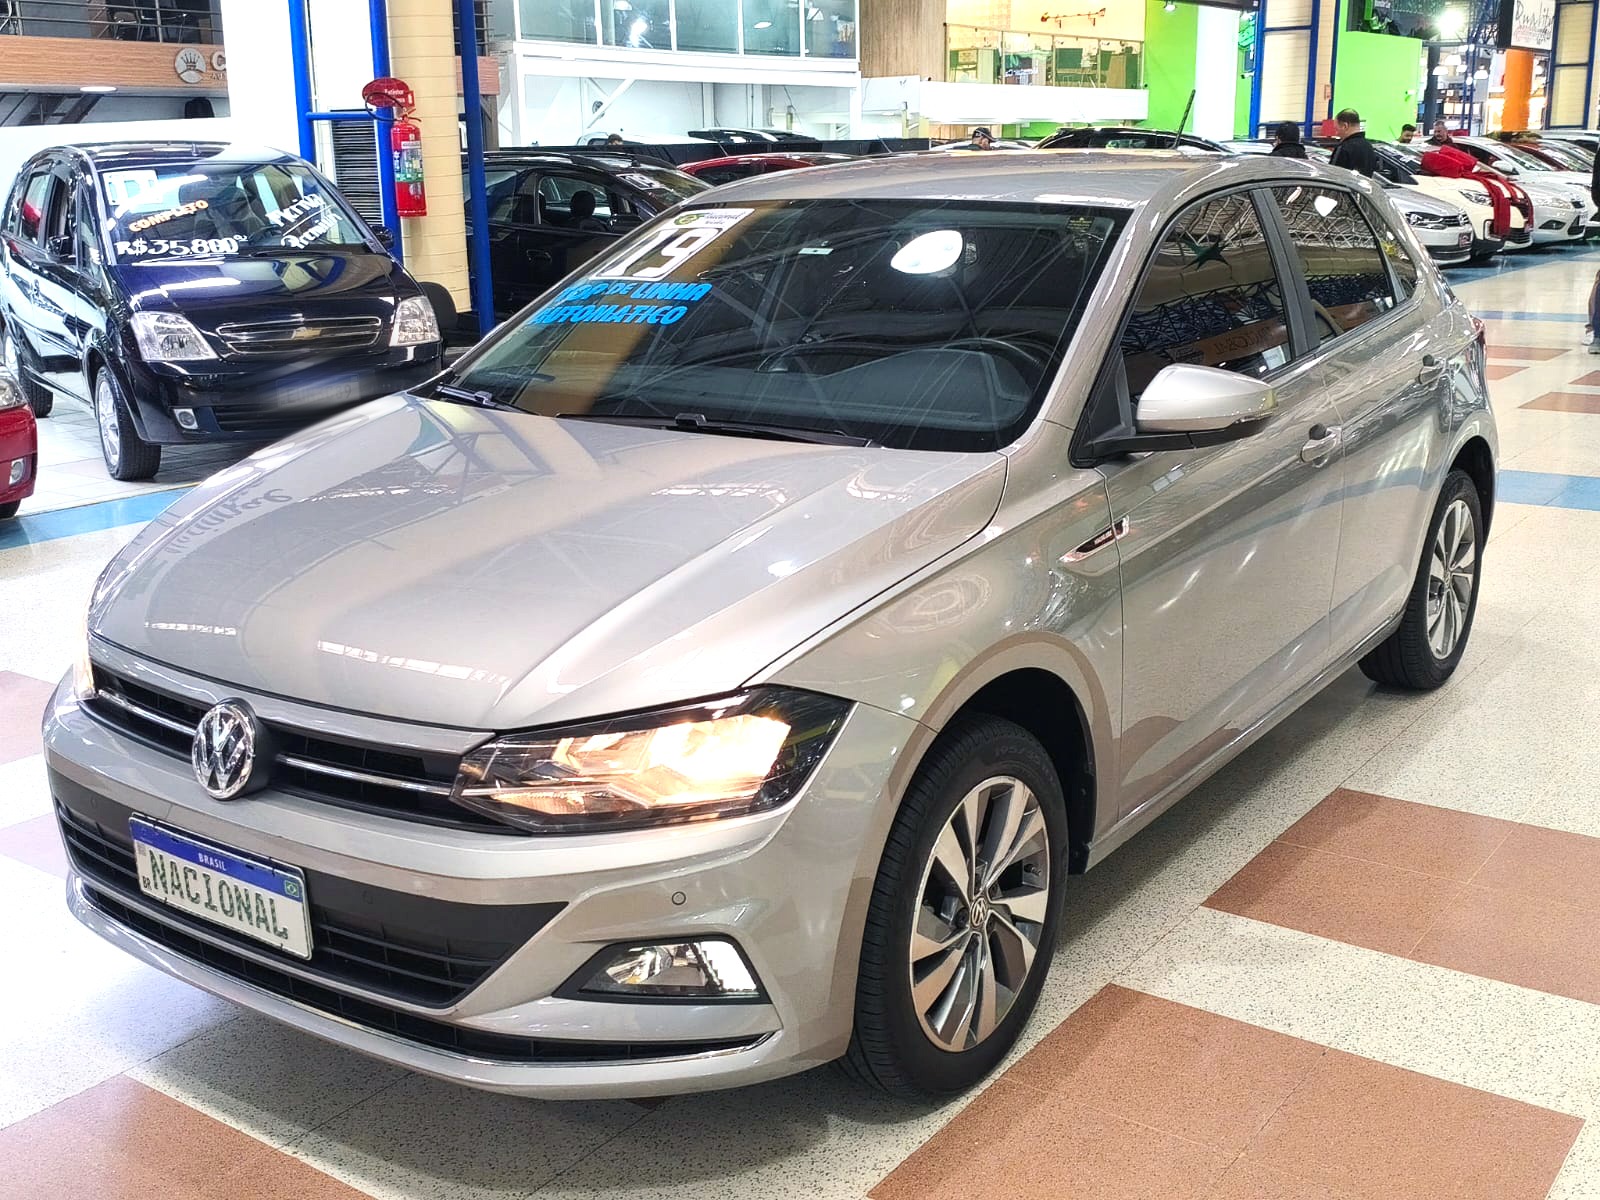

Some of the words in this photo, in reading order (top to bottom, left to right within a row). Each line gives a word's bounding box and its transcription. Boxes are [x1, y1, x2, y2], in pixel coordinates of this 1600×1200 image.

[129, 200, 208, 232] COMPLETO
[598, 228, 718, 278] 19
[630, 282, 713, 301] LINHA
[198, 852, 227, 872] BRASIL
[149, 849, 289, 940] NACIONAL
